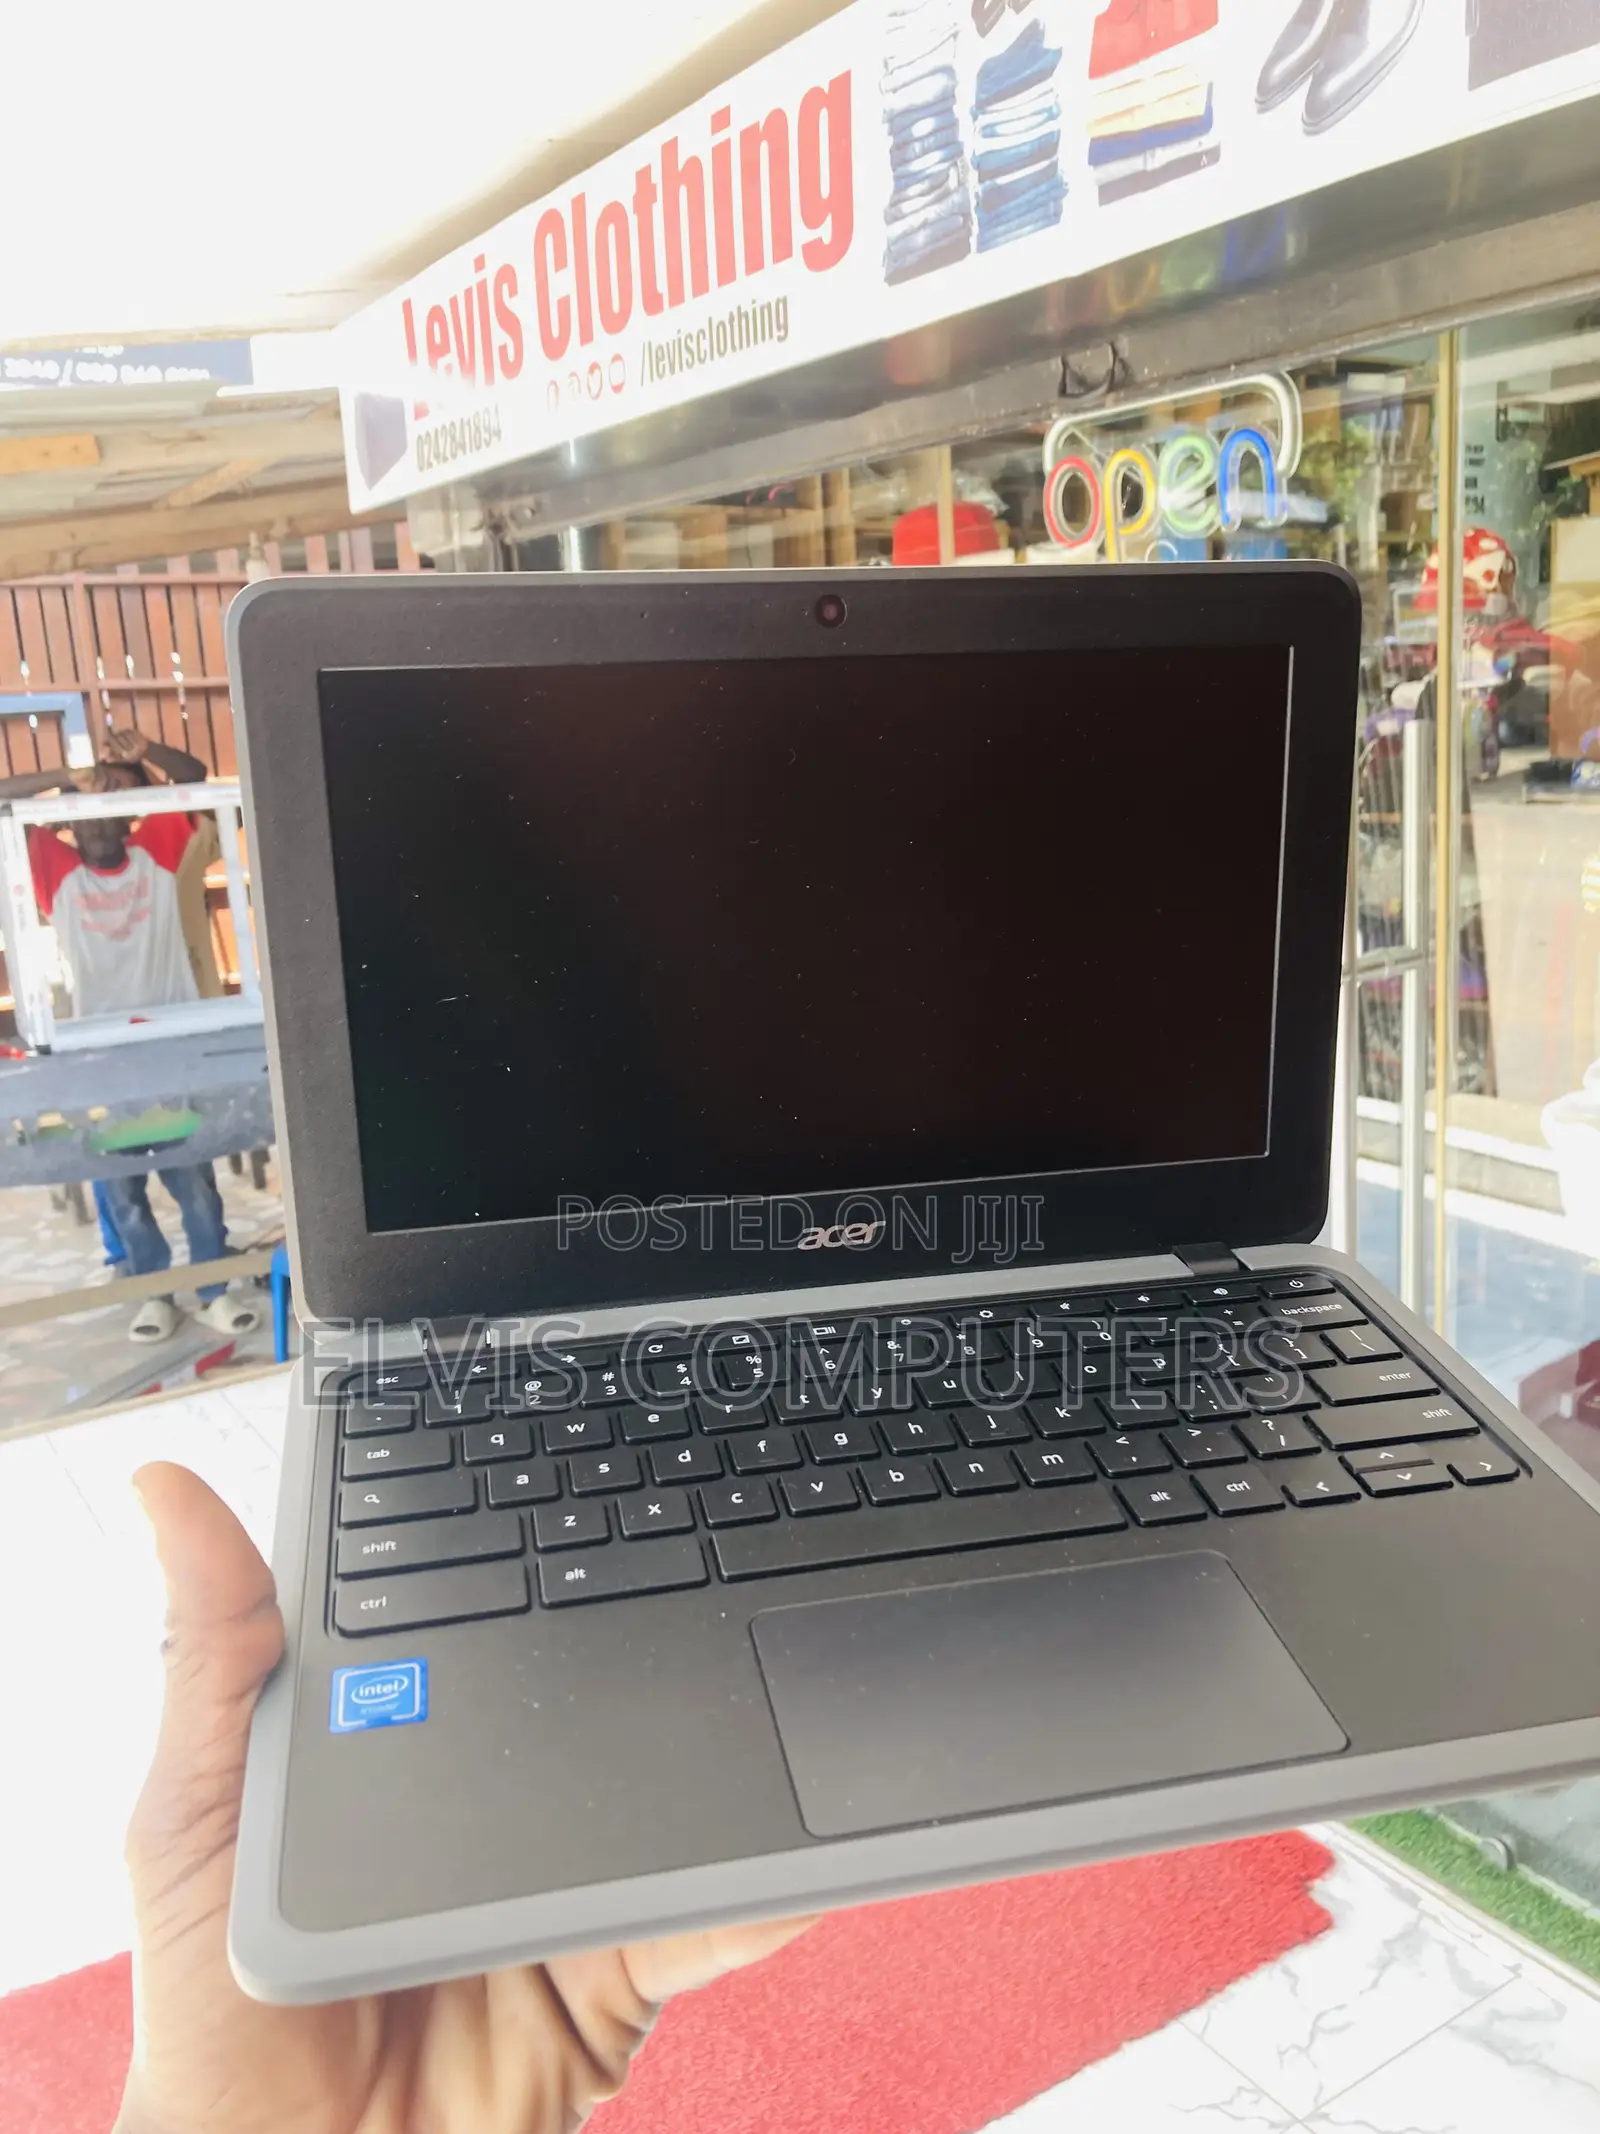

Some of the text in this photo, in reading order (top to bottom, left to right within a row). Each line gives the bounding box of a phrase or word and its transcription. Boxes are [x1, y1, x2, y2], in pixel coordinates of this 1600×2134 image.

[533, 68, 855, 362] Clothing
[641, 295, 790, 387] /levisclothing
[1042, 427, 1282, 564] open
[797, 1219, 886, 1251] acer
[1280, 1301, 1343, 1317] backspace
[1031, 1338, 1044, 1348] 9
[745, 1355, 762, 1365] %
[893, 1352, 905, 1362] 7
[676, 1362, 688, 1374] $
[824, 1360, 836, 1370] 6
[602, 1371, 615, 1382] #
[752, 1367, 764, 1378] 5
[1378, 1371, 1412, 1382] enter
[375, 1375, 399, 1385] esc
[524, 1380, 542, 1392] @
[679, 1376, 692, 1386] 4
[942, 1379, 957, 1389] u
[605, 1385, 617, 1396] 3
[870, 1386, 883, 1399] y
[799, 1393, 810, 1404] t
[724, 1404, 733, 1414] r
[1054, 1406, 1072, 1419] k
[1422, 1407, 1453, 1420] shift
[648, 1412, 660, 1423] e
[986, 1414, 997, 1429] j
[566, 1422, 586, 1434] w
[907, 1422, 924, 1434] h
[490, 1433, 505, 1446] q
[833, 1432, 849, 1446] g
[757, 1439, 768, 1453] f
[366, 1448, 391, 1460] tab
[677, 1449, 692, 1464] d
[1041, 1453, 1065, 1466] m
[598, 1462, 611, 1474] s
[968, 1461, 985, 1474] n
[515, 1474, 529, 1486] a
[888, 1468, 905, 1483] b
[810, 1480, 824, 1493] v
[1225, 1480, 1251, 1494] ctrl
[730, 1491, 744, 1504] c
[1149, 1489, 1172, 1503] alt
[647, 1502, 663, 1516] x
[564, 1514, 577, 1527] z
[361, 1540, 398, 1555] shift
[564, 1567, 587, 1581] alt
[359, 1595, 388, 1611] ctrl
[359, 1679, 399, 1698] intel
